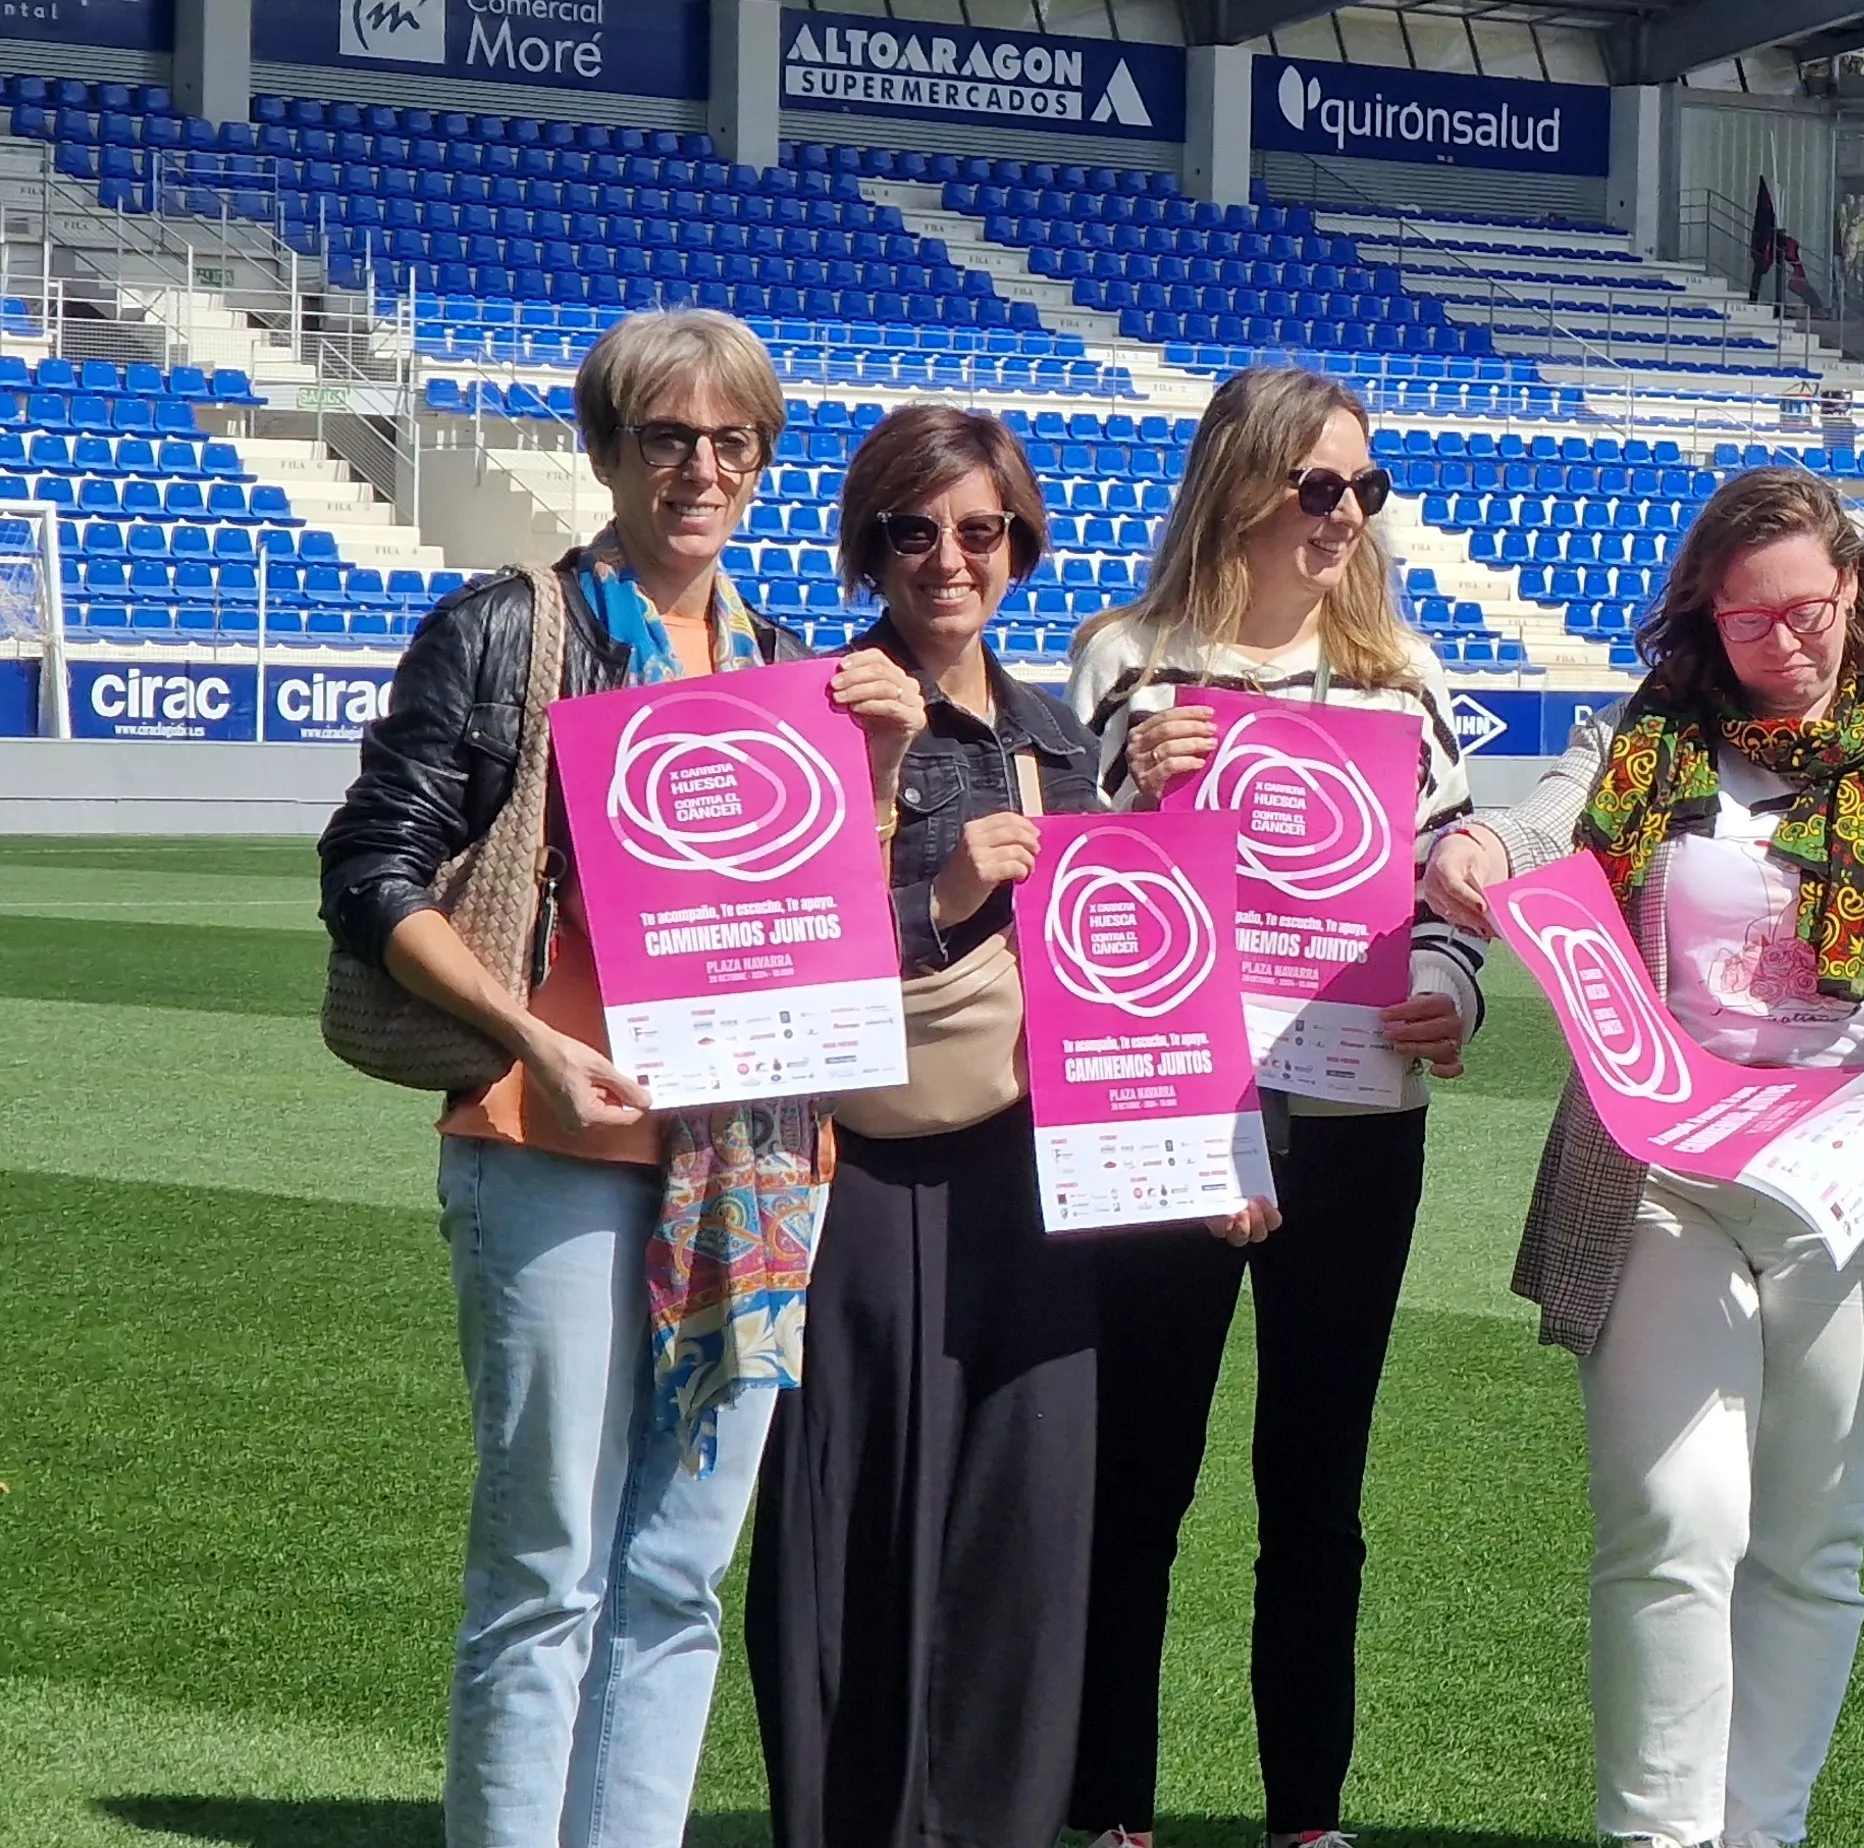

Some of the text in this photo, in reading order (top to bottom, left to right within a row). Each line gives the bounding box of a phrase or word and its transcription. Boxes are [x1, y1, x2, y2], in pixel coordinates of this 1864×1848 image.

[466, 14, 603, 78] Moré
[787, 22, 1082, 87] ALTOARAGON
[801, 70, 1067, 115] SUPERMERCADOS
[1320, 93, 1561, 152] quirónsalud
[91, 668, 231, 720] cirac
[681, 762, 734, 779] CARRERA
[671, 774, 737, 795] HUESCA
[1264, 783, 1306, 796] CARRERA
[674, 793, 741, 810] CONTRA EL
[1254, 792, 1307, 810] HUESCA
[676, 802, 742, 822] CANCER
[1252, 810, 1306, 824] CONTRA EL
[1251, 819, 1306, 836] CANCER
[1089, 913, 1137, 928] HUESCA
[645, 914, 841, 956] CAMINEMOS JUNTOS
[1092, 940, 1139, 955] CANCER
[1235, 927, 1369, 964] INEMOS JUNTOS
[706, 953, 793, 974] PLAZA NAVARRA
[1242, 961, 1319, 981] PLAZA NAVARRA
[1065, 1050, 1213, 1083] CAMINEMOS JUNTOS
[1109, 1085, 1176, 1101] PLAZA NAVARRA
